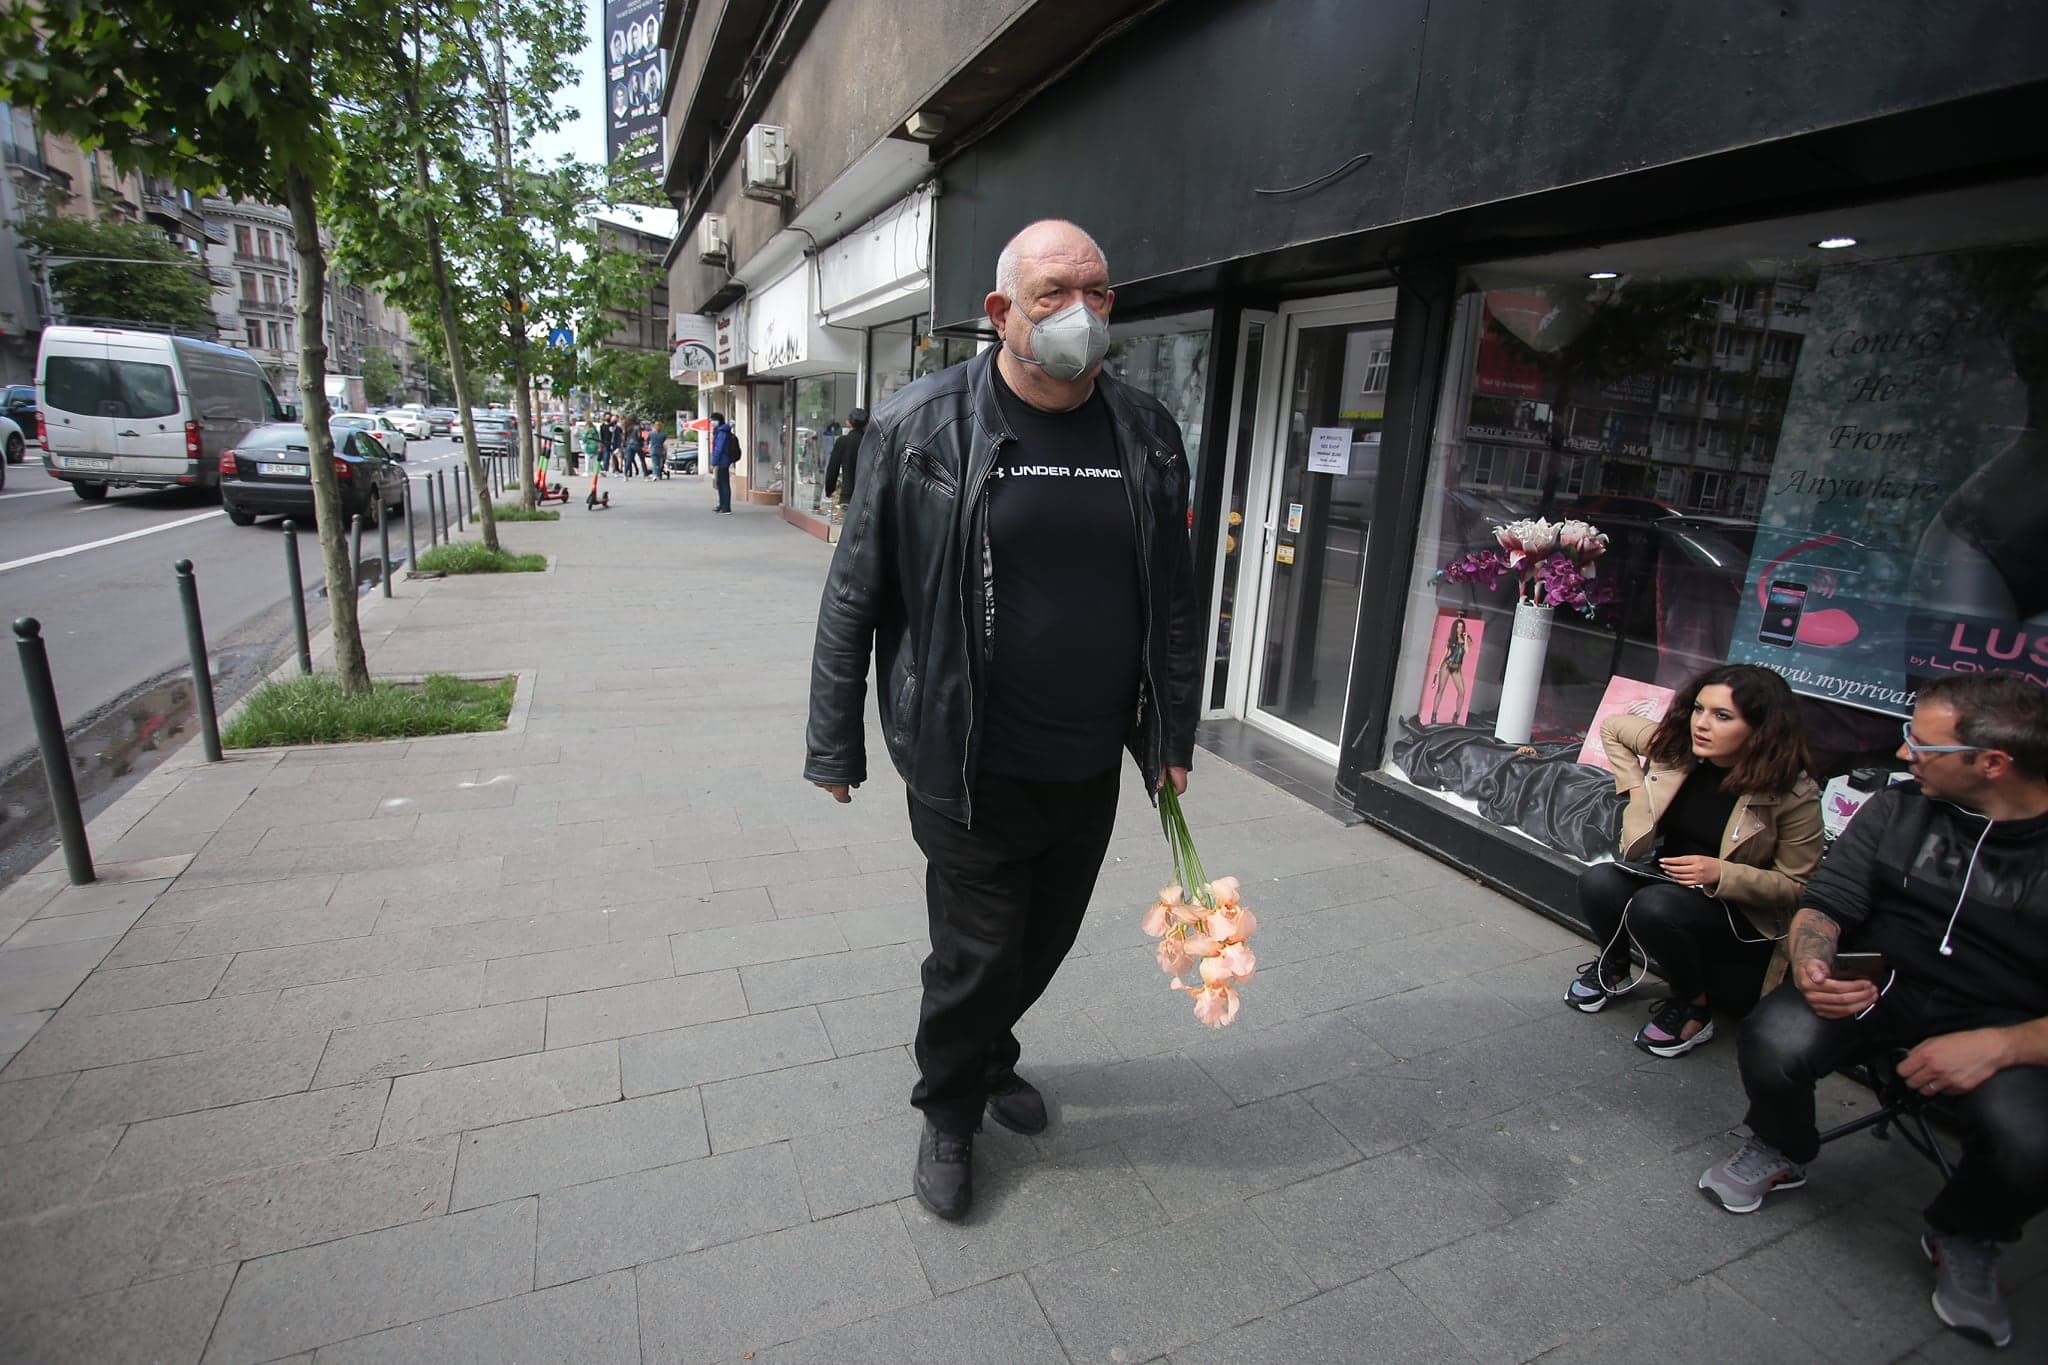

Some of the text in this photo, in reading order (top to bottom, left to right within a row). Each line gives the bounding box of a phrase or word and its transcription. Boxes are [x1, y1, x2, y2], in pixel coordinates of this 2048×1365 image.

[1830, 425, 1914, 450] From
[1010, 465, 1071, 477] UNDER
[1774, 470, 1938, 504] Anywhere
[1909, 655, 1927, 666] by
